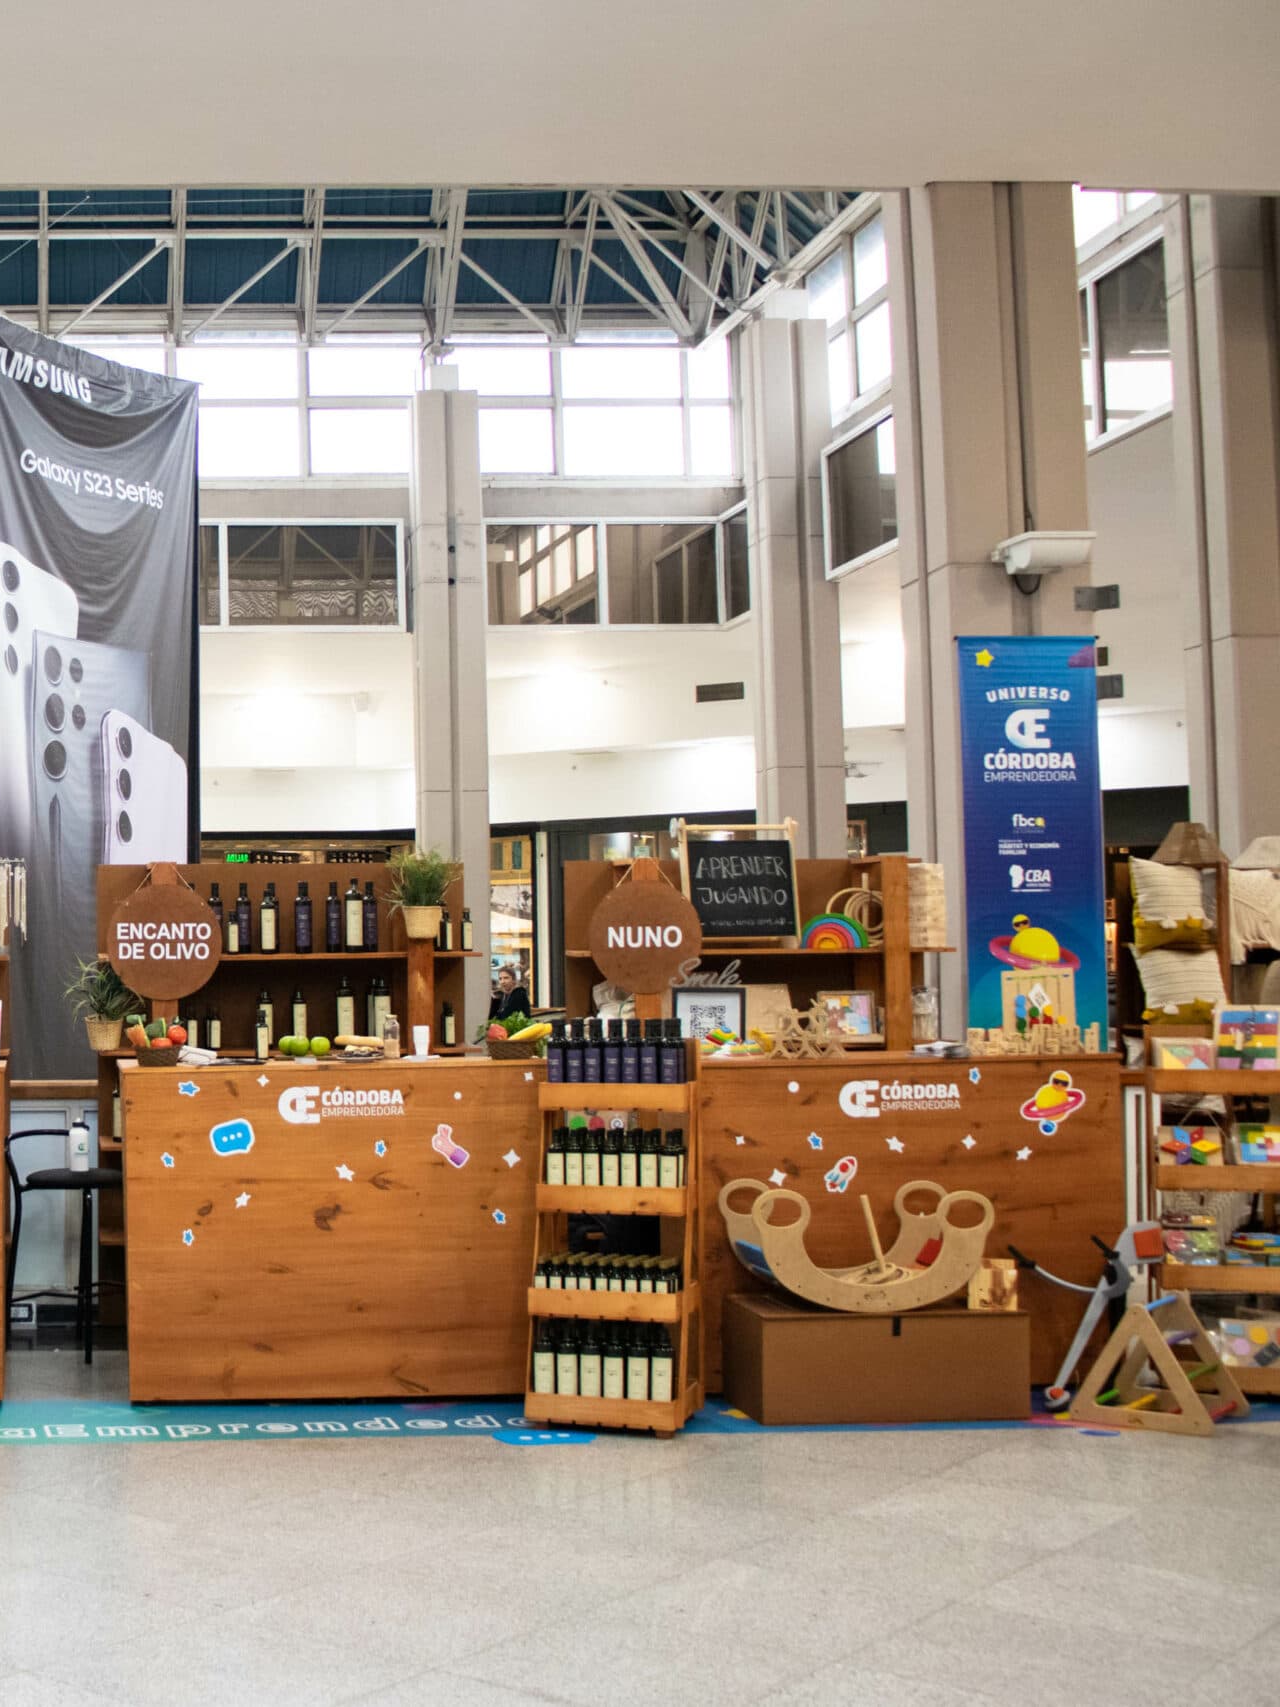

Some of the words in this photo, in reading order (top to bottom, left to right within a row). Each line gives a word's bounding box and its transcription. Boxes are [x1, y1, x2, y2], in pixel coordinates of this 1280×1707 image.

[20, 449, 81, 494] Galaxy
[84, 470, 113, 498] S23
[115, 478, 164, 509] Series
[986, 686, 1070, 703] UNIVERSO
[984, 749, 1076, 770] CÓRDOBA
[984, 771, 1076, 783] EMPRENDEDORA
[695, 856, 788, 879] APRENDER
[1025, 869, 1052, 882] CBA
[696, 886, 787, 905] JUGANDO
[116, 922, 212, 940] ENCANTO
[607, 925, 683, 948] NUNO
[118, 942, 145, 960] DE
[149, 942, 210, 960] OLIVO
[321, 1086, 404, 1106] CÓRDOBA
[880, 1080, 960, 1100] CÓRDOBA
[321, 1106, 405, 1117] EMPRENDEDORA
[880, 1100, 961, 1111] EMPRENDEDORA
